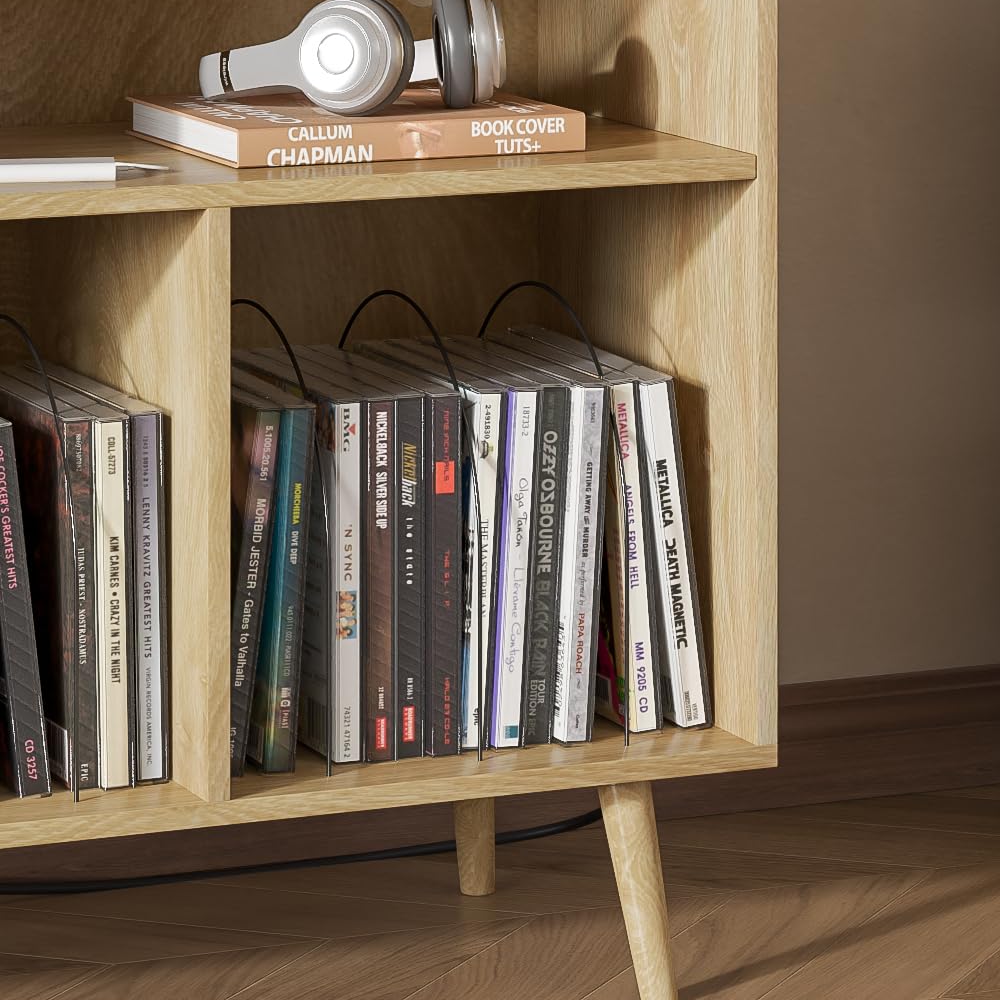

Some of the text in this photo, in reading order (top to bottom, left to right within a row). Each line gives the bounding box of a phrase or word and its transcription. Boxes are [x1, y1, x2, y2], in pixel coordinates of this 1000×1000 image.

[288, 125, 352, 141] CALLUM
[471, 117, 565, 137] BOOK COVER
[267, 144, 372, 166] CHAPMAN
[494, 137, 541, 154] TUTS+
[484, 404, 492, 439] 2-491830
[522, 406, 530, 436] 18733-2
[617, 403, 630, 460] METALLICA
[541, 431, 558, 474] OZZY
[376, 411, 387, 529] NICKELBACK SILVER SIDE UP
[585, 462, 593, 492] GETTING
[514, 478, 528, 508] Olga
[252, 498, 266, 543] MORBID
[290, 483, 302, 564] MORCHEEBA DIVE DEEP
[536, 478, 555, 575] OSBOURNE
[1, 516, 15, 564] GREATEST
[581, 527, 590, 558] MURDER
[628, 530, 638, 560] FROM
[655, 459, 688, 649] METALLICA DEATH MAGNETIC
[7, 567, 17, 588] HITS
[142, 497, 152, 658] LENNY KRAVITZ GREATEST HITS
[246, 546, 261, 589] JESTER
[344, 545, 353, 581] SYNC
[629, 566, 639, 589] HELL
[110, 537, 120, 683] KIM CARNES CRAZY IN THE NIGHT
[241, 599, 254, 629] Gates
[534, 579, 551, 632] BLACK
[79, 609, 87, 664] NOSTRADAMUS
[240, 633, 250, 643] to
[577, 613, 585, 637] PAPA
[505, 622, 521, 673] Contigo
[575, 640, 584, 674] ROACH
[635, 642, 644, 661] MM
[234, 646, 248, 687] Valhalla
[636, 666, 647, 691] 9205
[528, 680, 538, 716] EDITION
[537, 679, 546, 703] TOUR
[639, 697, 648, 713] CD
[25, 739, 37, 779] CD 3257
[80, 763, 88, 781] EPIC
